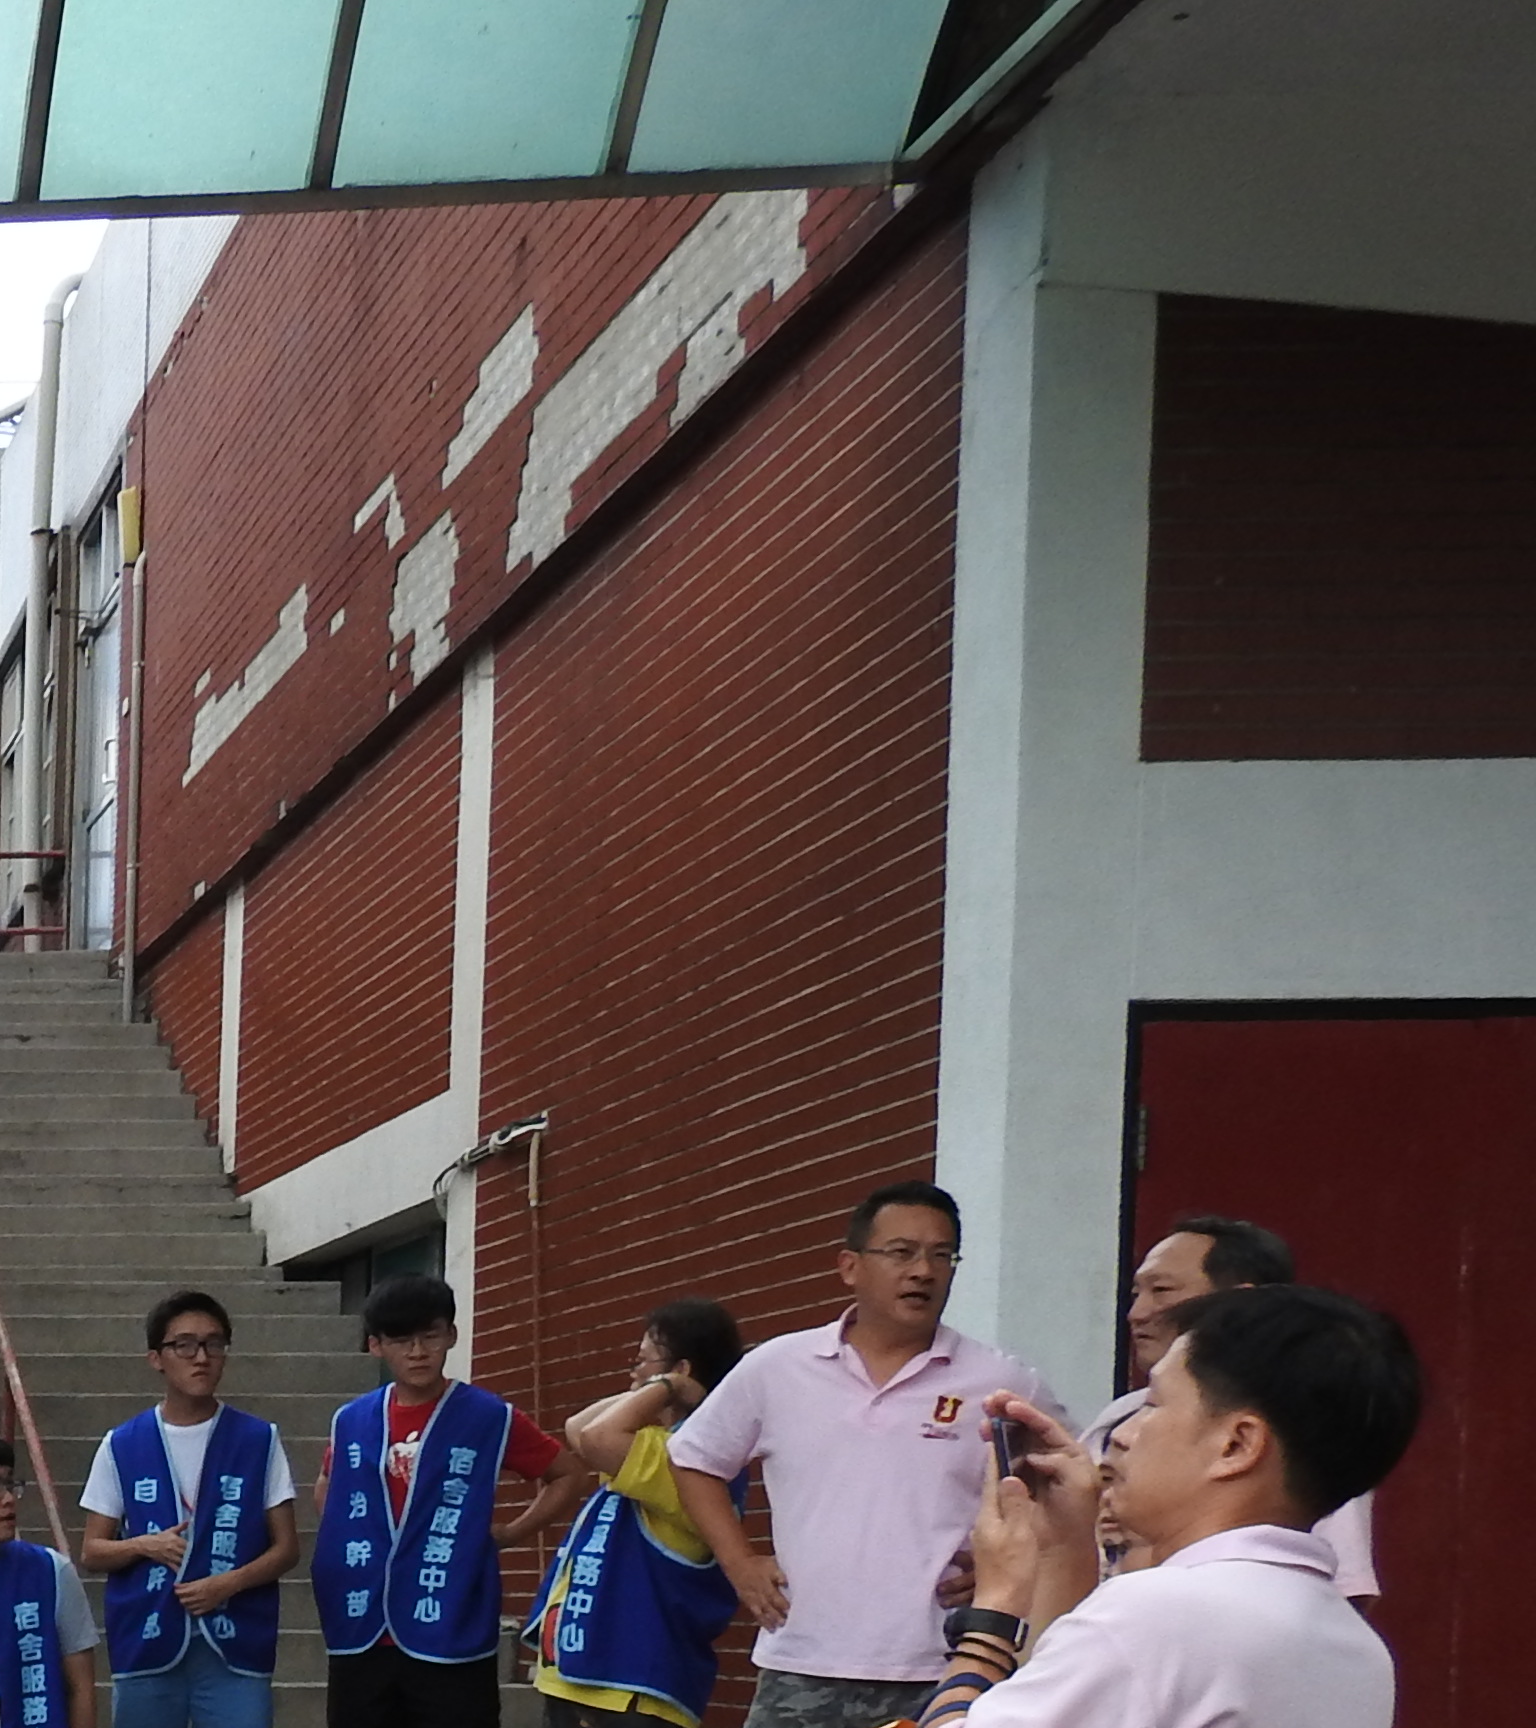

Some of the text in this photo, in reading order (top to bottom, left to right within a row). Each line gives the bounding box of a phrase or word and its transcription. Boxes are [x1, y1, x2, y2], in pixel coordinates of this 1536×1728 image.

[413, 1447, 477, 1623] 宿舍服務中心
